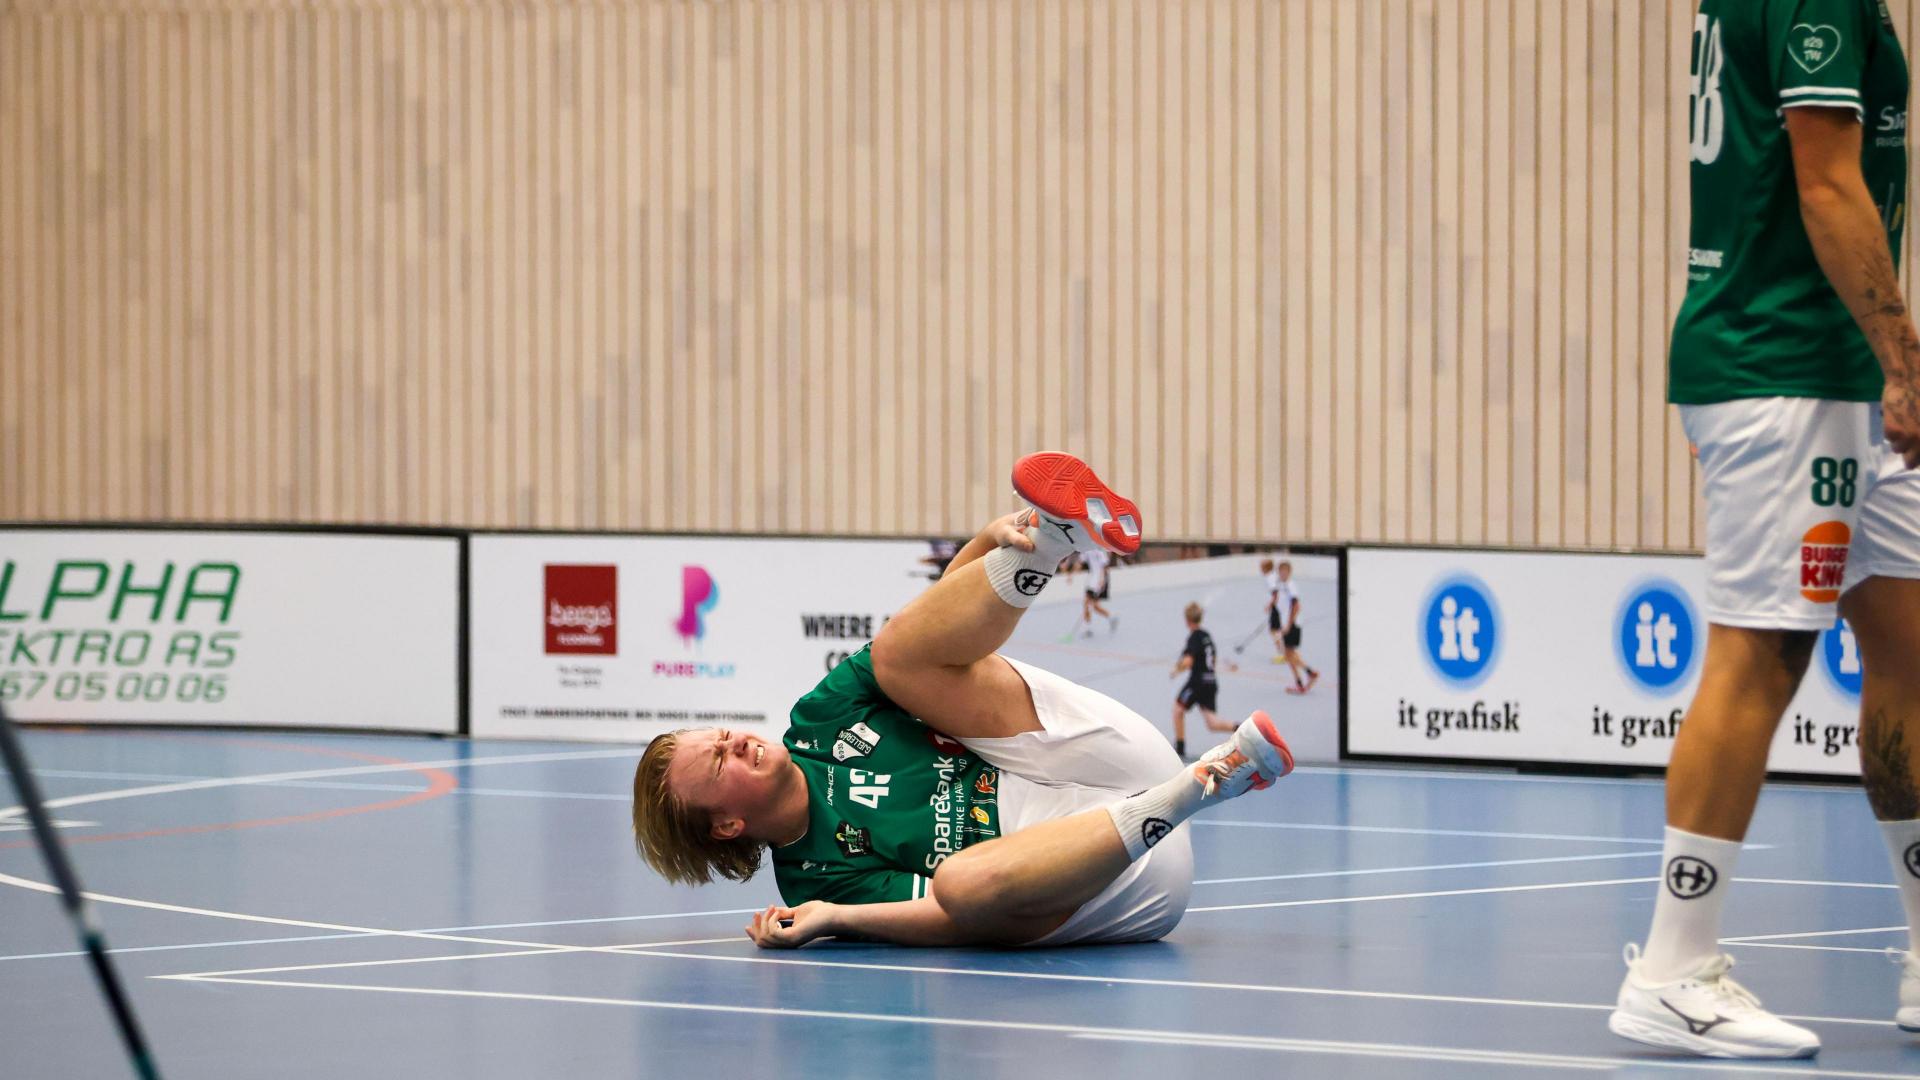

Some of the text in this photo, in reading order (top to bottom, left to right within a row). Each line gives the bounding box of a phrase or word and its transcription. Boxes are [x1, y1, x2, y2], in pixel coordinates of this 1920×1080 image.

[1811, 457, 1858, 508] 88
[1801, 546, 1849, 563] BURGE
[0, 559, 242, 622] LPHA
[801, 614, 872, 640] WHERE
[1439, 595, 1480, 662] it
[1636, 601, 1678, 670] it
[165, 630, 242, 668] AS
[653, 661, 736, 677] PUREPLAY
[1398, 698, 1519, 740] it grafisk
[1593, 704, 1684, 748] it graf
[1794, 714, 1861, 757] it gr
[826, 765, 835, 806] UNIHOC
[849, 768, 891, 809] 43
[925, 756, 955, 870] SpareBank
[954, 806, 966, 853] GERIKE
